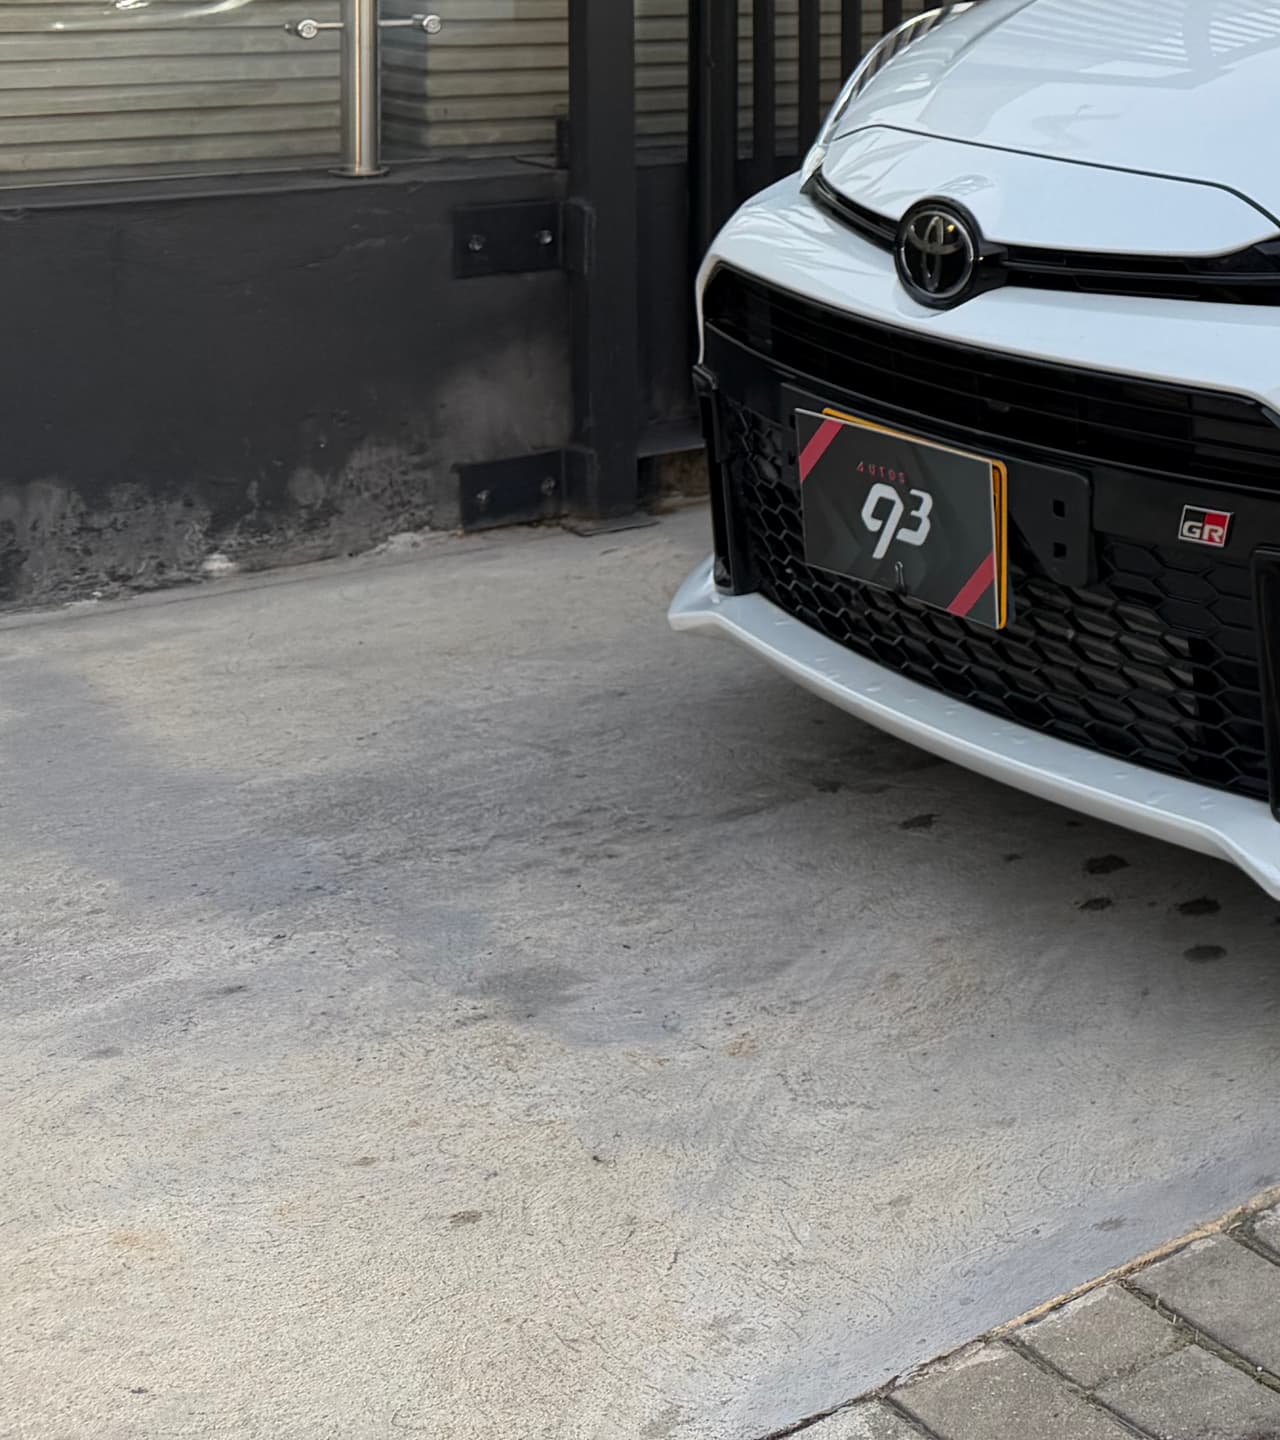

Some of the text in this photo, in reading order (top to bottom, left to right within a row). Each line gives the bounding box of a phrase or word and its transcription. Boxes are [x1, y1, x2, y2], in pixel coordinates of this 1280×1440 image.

[856, 461, 906, 486] AUTOS
[861, 482, 934, 560] 93
[1182, 520, 1225, 543] GR
